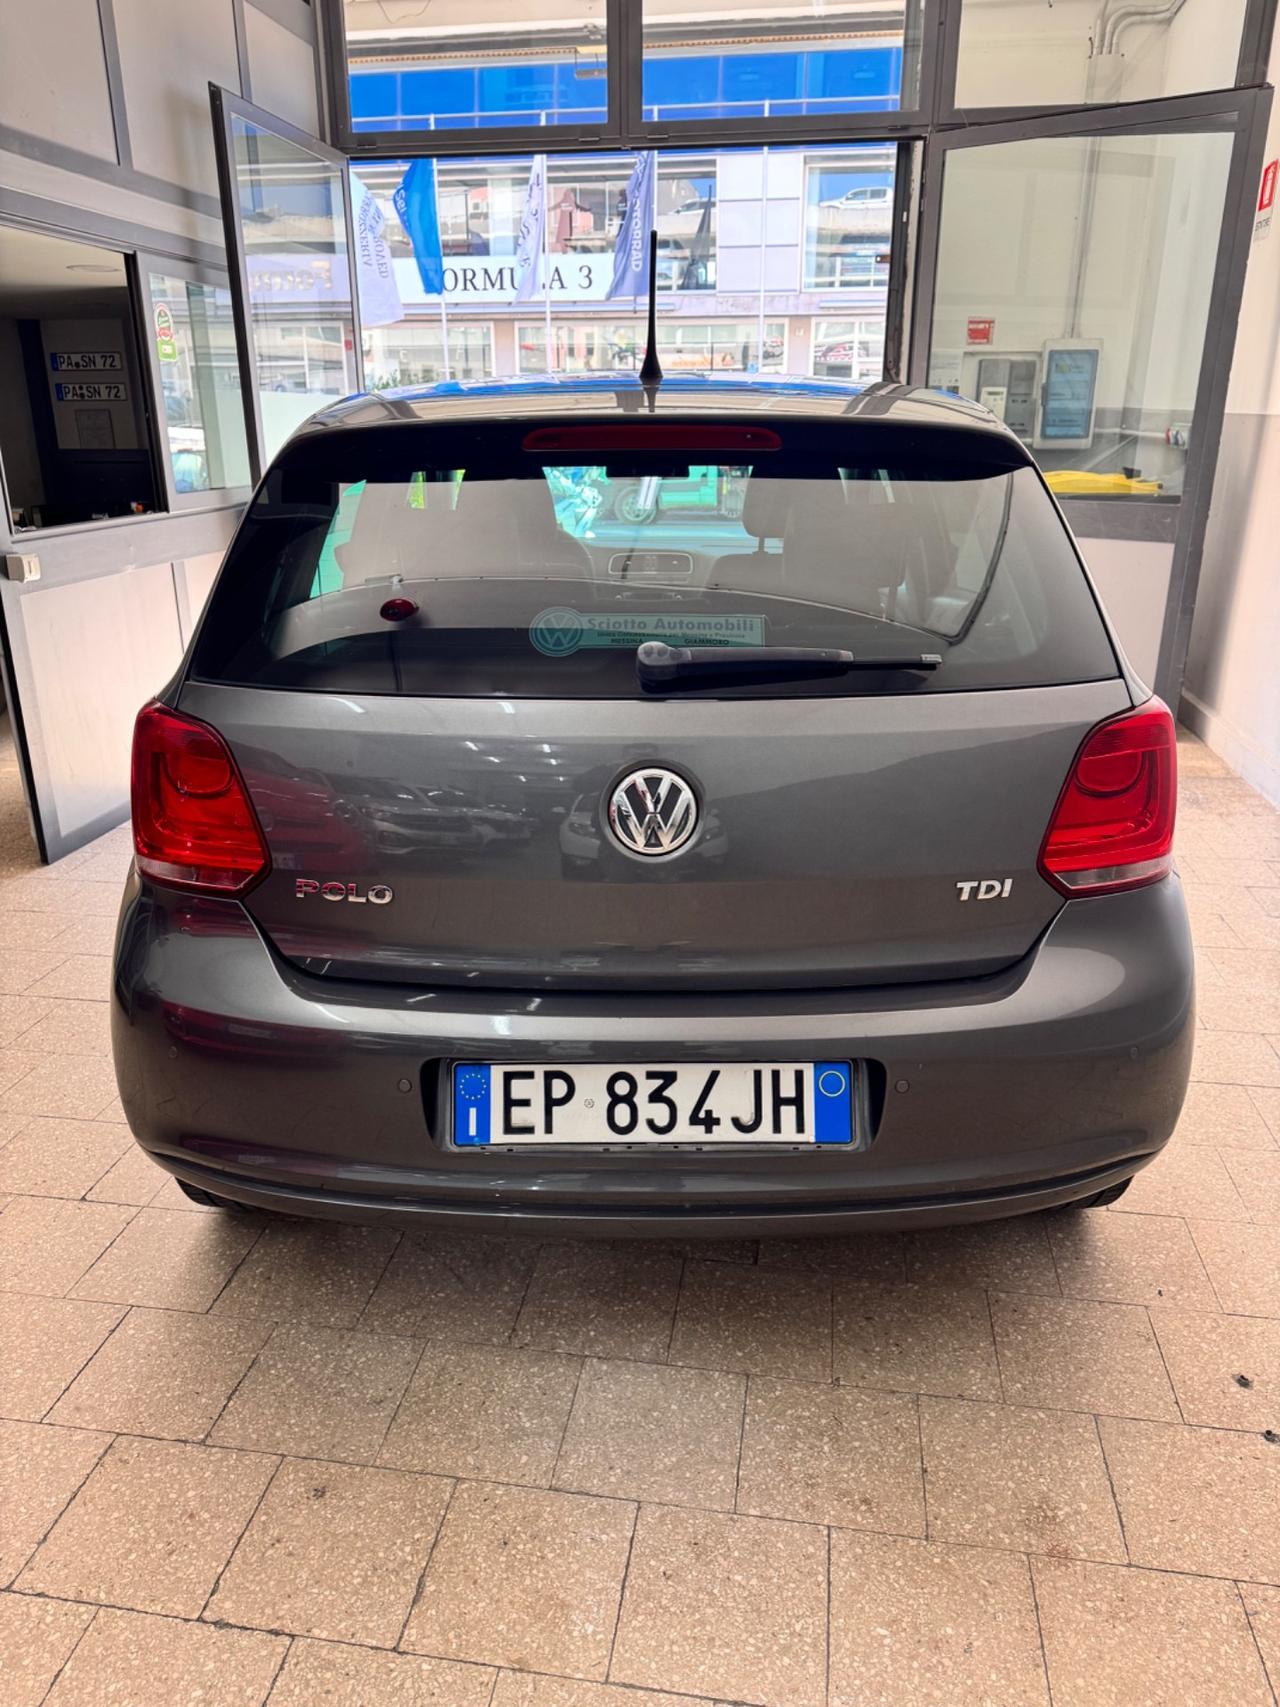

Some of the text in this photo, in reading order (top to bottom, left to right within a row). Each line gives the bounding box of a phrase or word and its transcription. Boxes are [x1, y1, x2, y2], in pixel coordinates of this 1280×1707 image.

[442, 265, 593, 292] ORMUA 3
[100, 355, 117, 368] 72
[105, 386, 121, 399] 72
[587, 617, 754, 632] Sciotto Automobili
[296, 878, 393, 904] POLO
[956, 878, 1013, 901] TDI
[502, 1070, 576, 1135] EP
